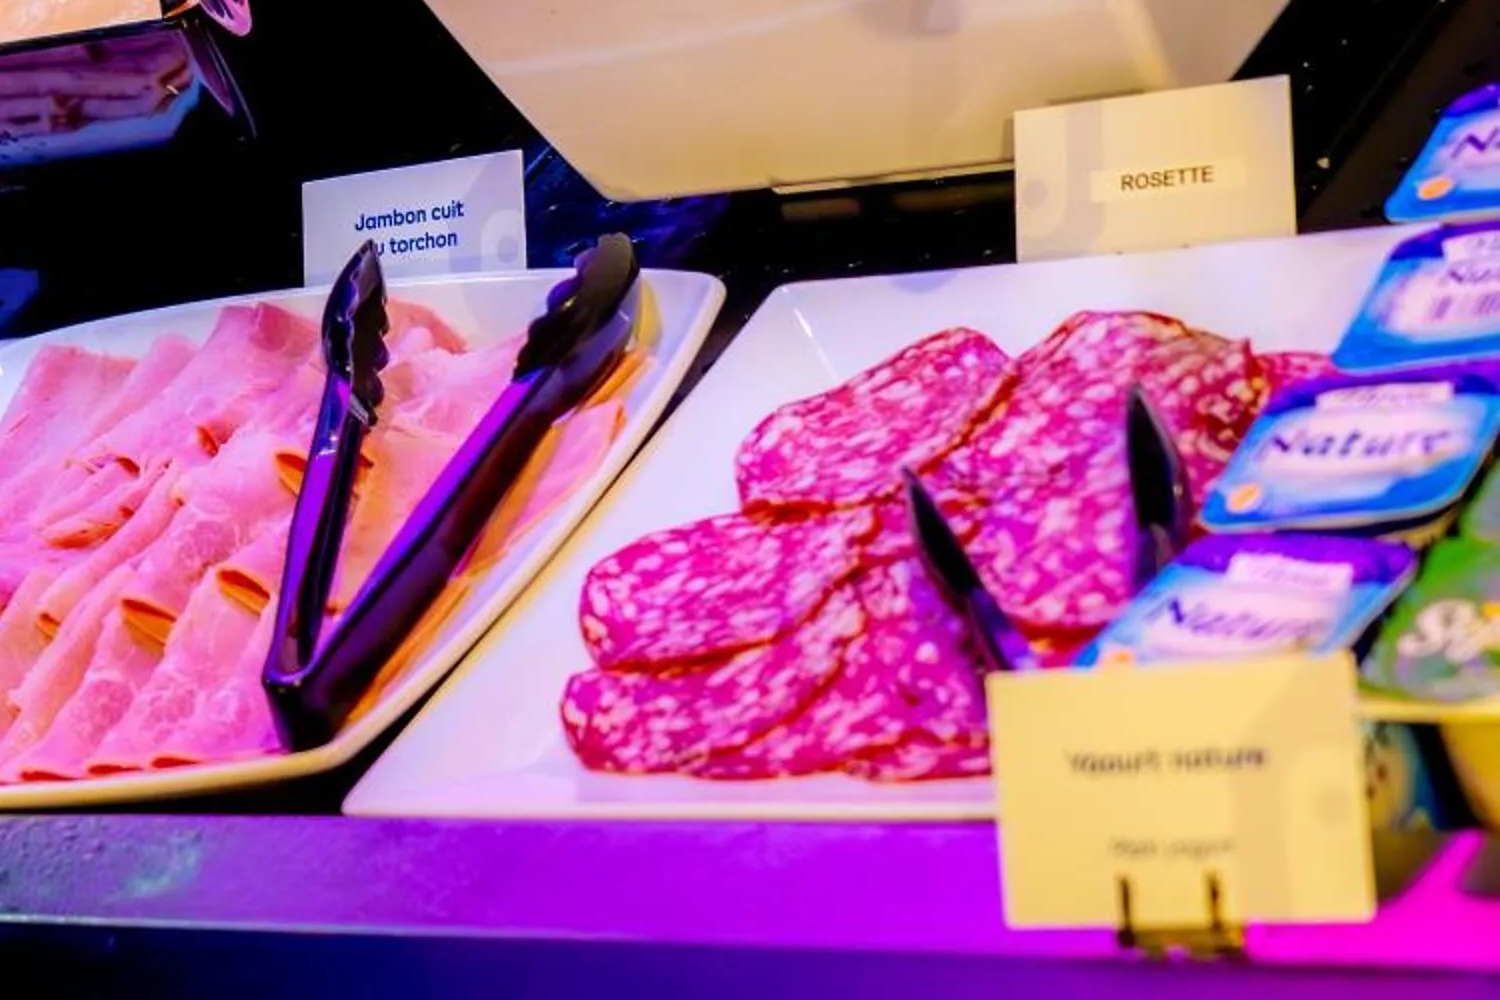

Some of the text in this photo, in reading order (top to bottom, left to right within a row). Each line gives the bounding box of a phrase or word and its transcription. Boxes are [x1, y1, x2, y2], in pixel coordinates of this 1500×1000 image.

[1120, 165, 1215, 191] ROSETTE
[355, 200, 465, 231] Jambon cuit
[389, 231, 459, 255] torchon
